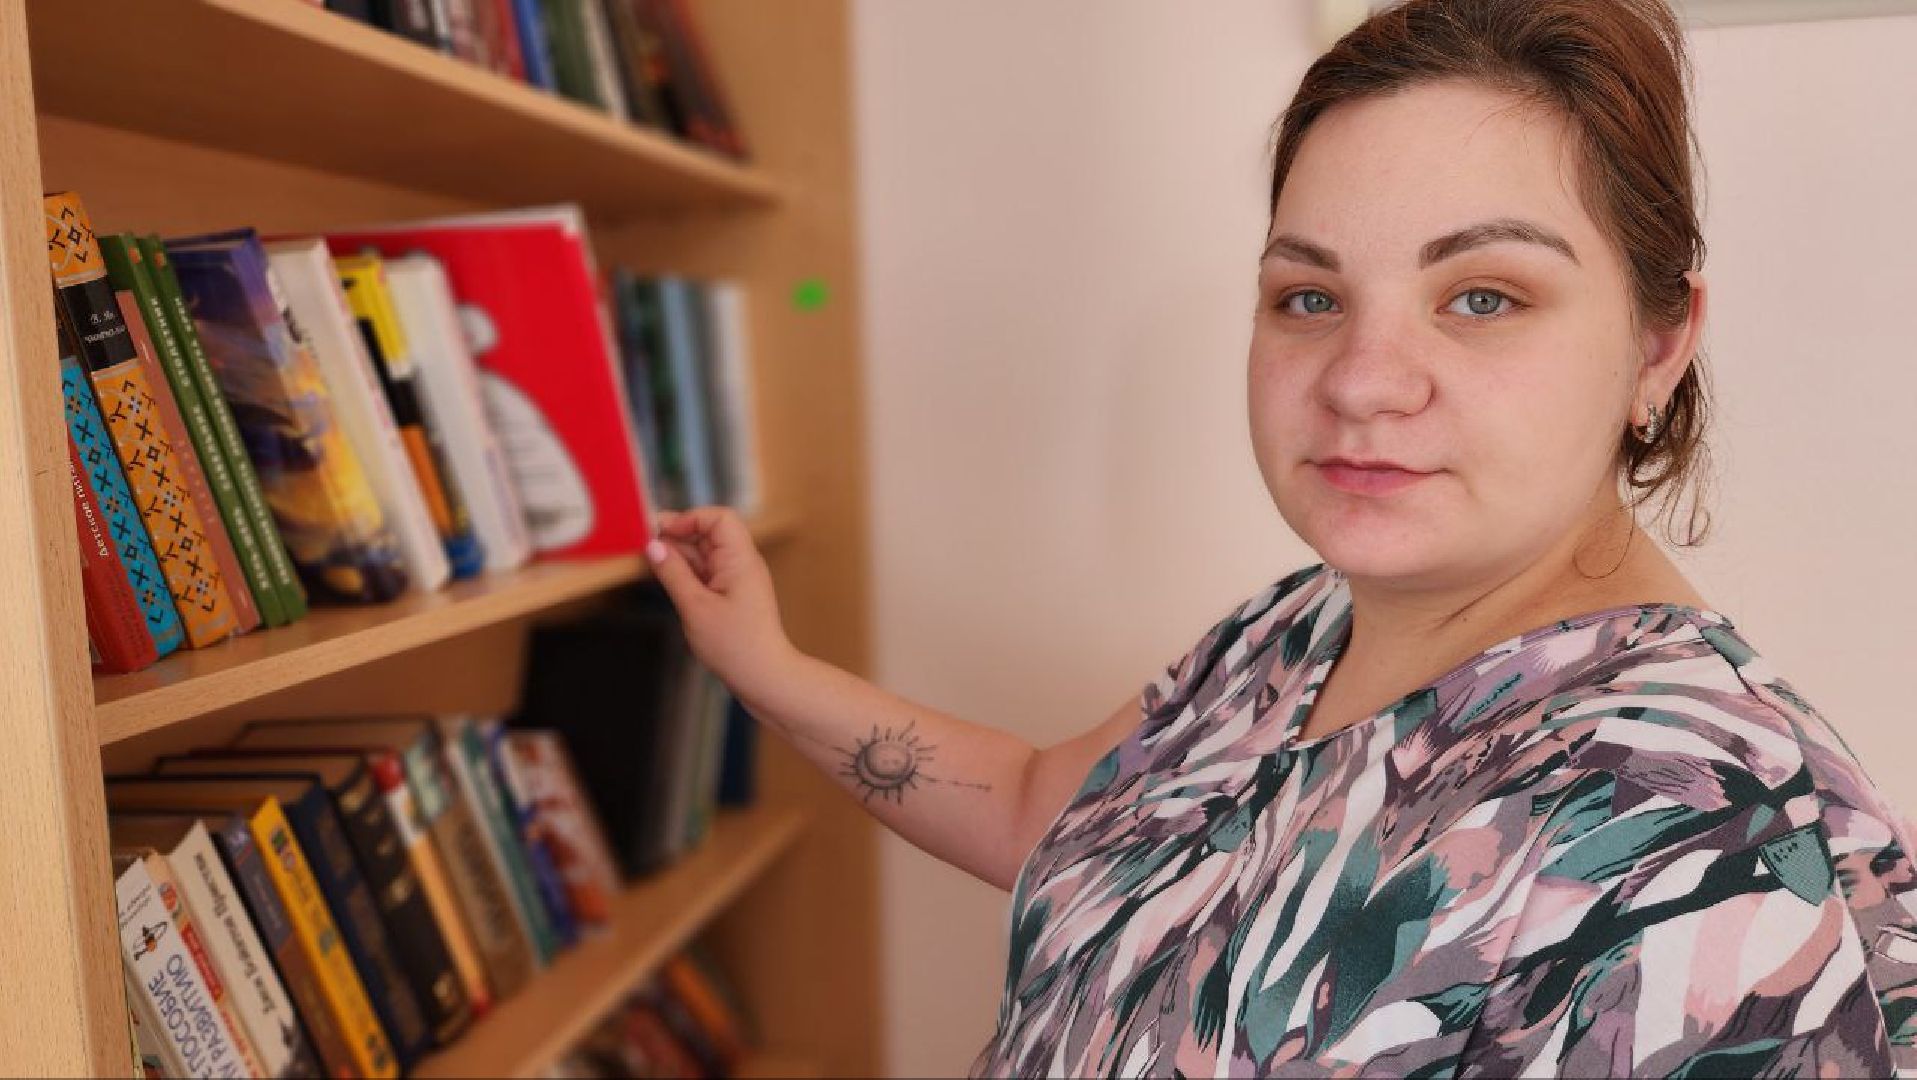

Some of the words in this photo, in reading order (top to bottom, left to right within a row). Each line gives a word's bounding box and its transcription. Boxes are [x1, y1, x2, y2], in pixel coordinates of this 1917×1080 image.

[82, 500, 109, 556] Детское
[149, 970, 205, 1072] ПОСОБИЕ
[166, 953, 227, 1061] РАЗВИТИЮ
